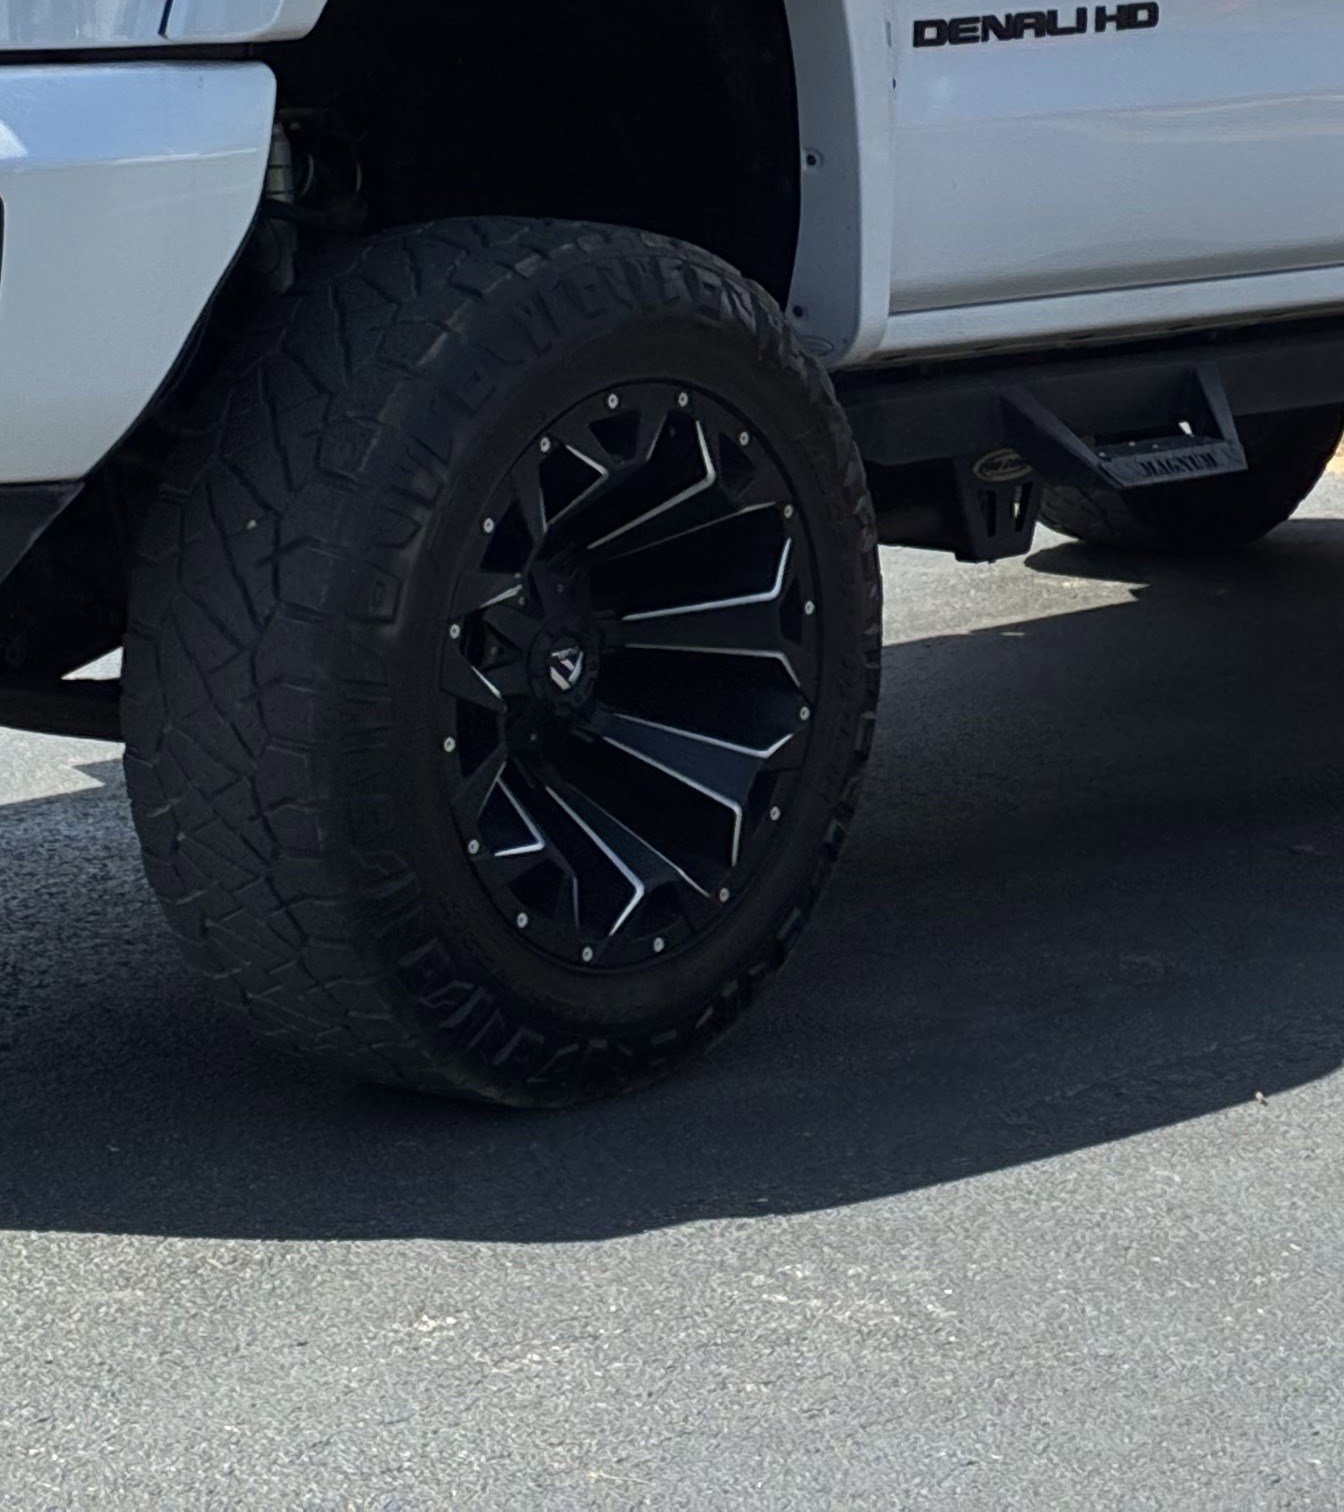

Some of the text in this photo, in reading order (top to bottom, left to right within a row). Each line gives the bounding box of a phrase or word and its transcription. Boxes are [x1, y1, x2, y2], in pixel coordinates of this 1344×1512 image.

[912, 1, 1160, 48] DENALI HD
[1139, 452, 1218, 477] MAGNUM
